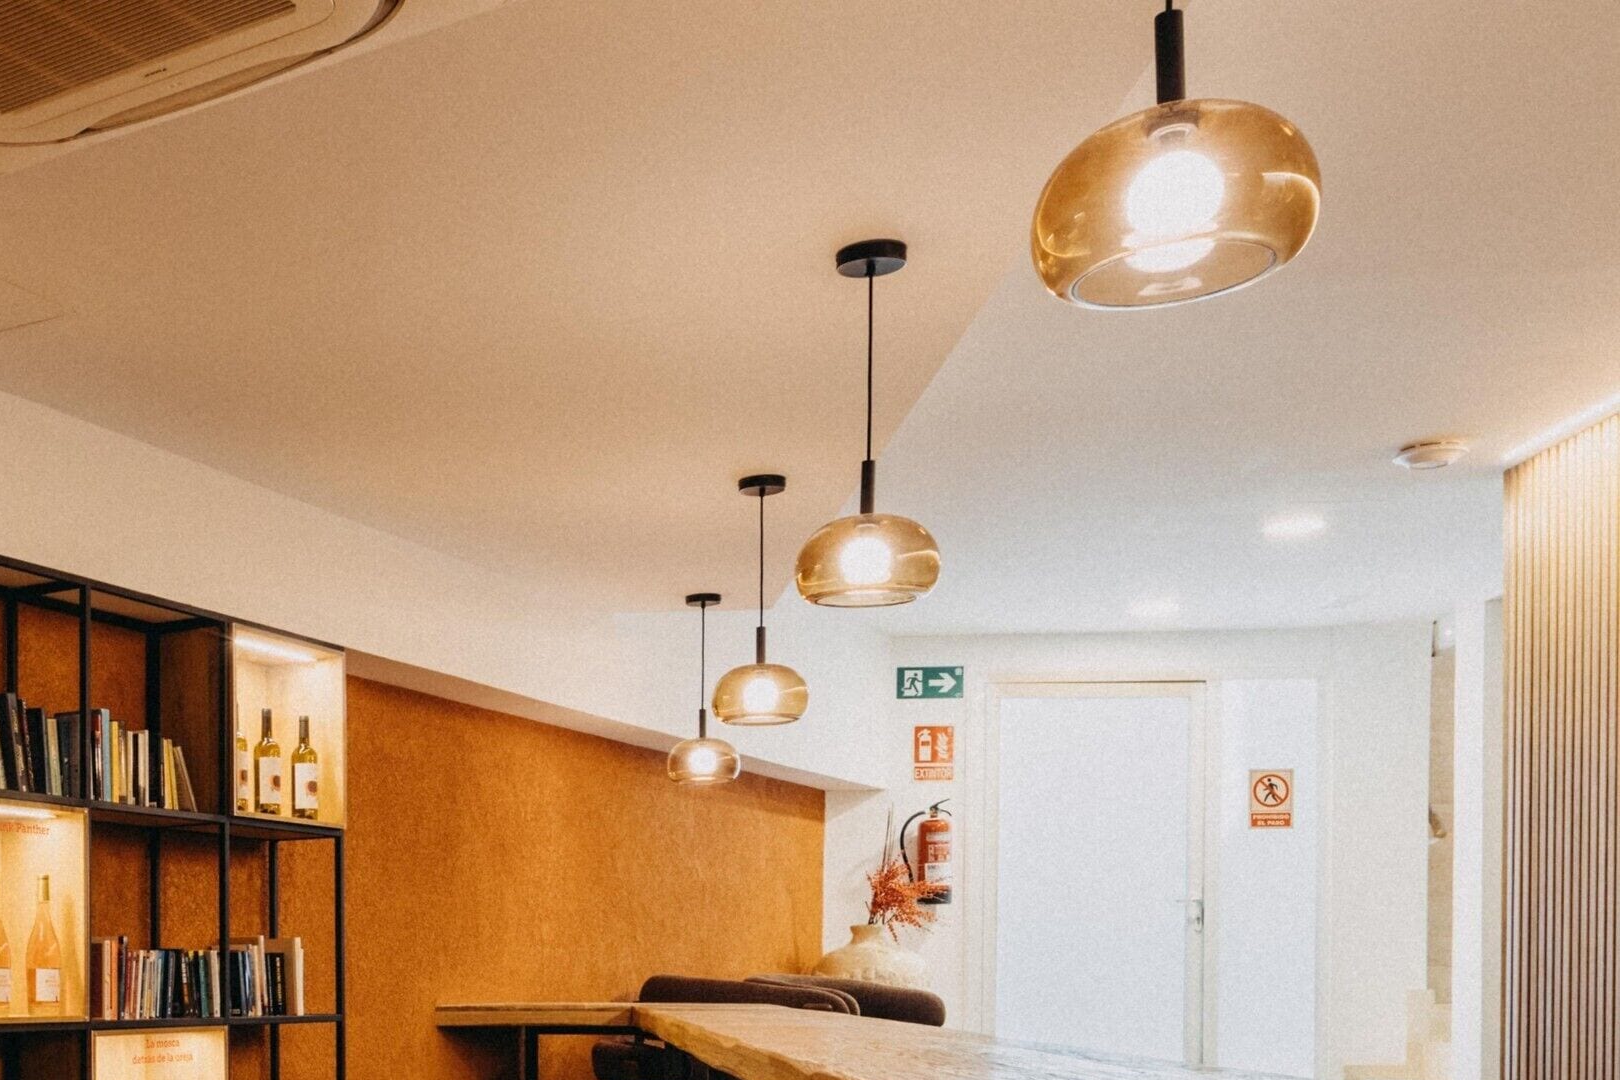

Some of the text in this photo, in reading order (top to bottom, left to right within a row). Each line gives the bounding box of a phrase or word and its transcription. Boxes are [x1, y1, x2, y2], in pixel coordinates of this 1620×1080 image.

[914, 768, 953, 780] EXTINTOR
[16, 822, 50, 836] Panther
[156, 1040, 180, 1048] mosca
